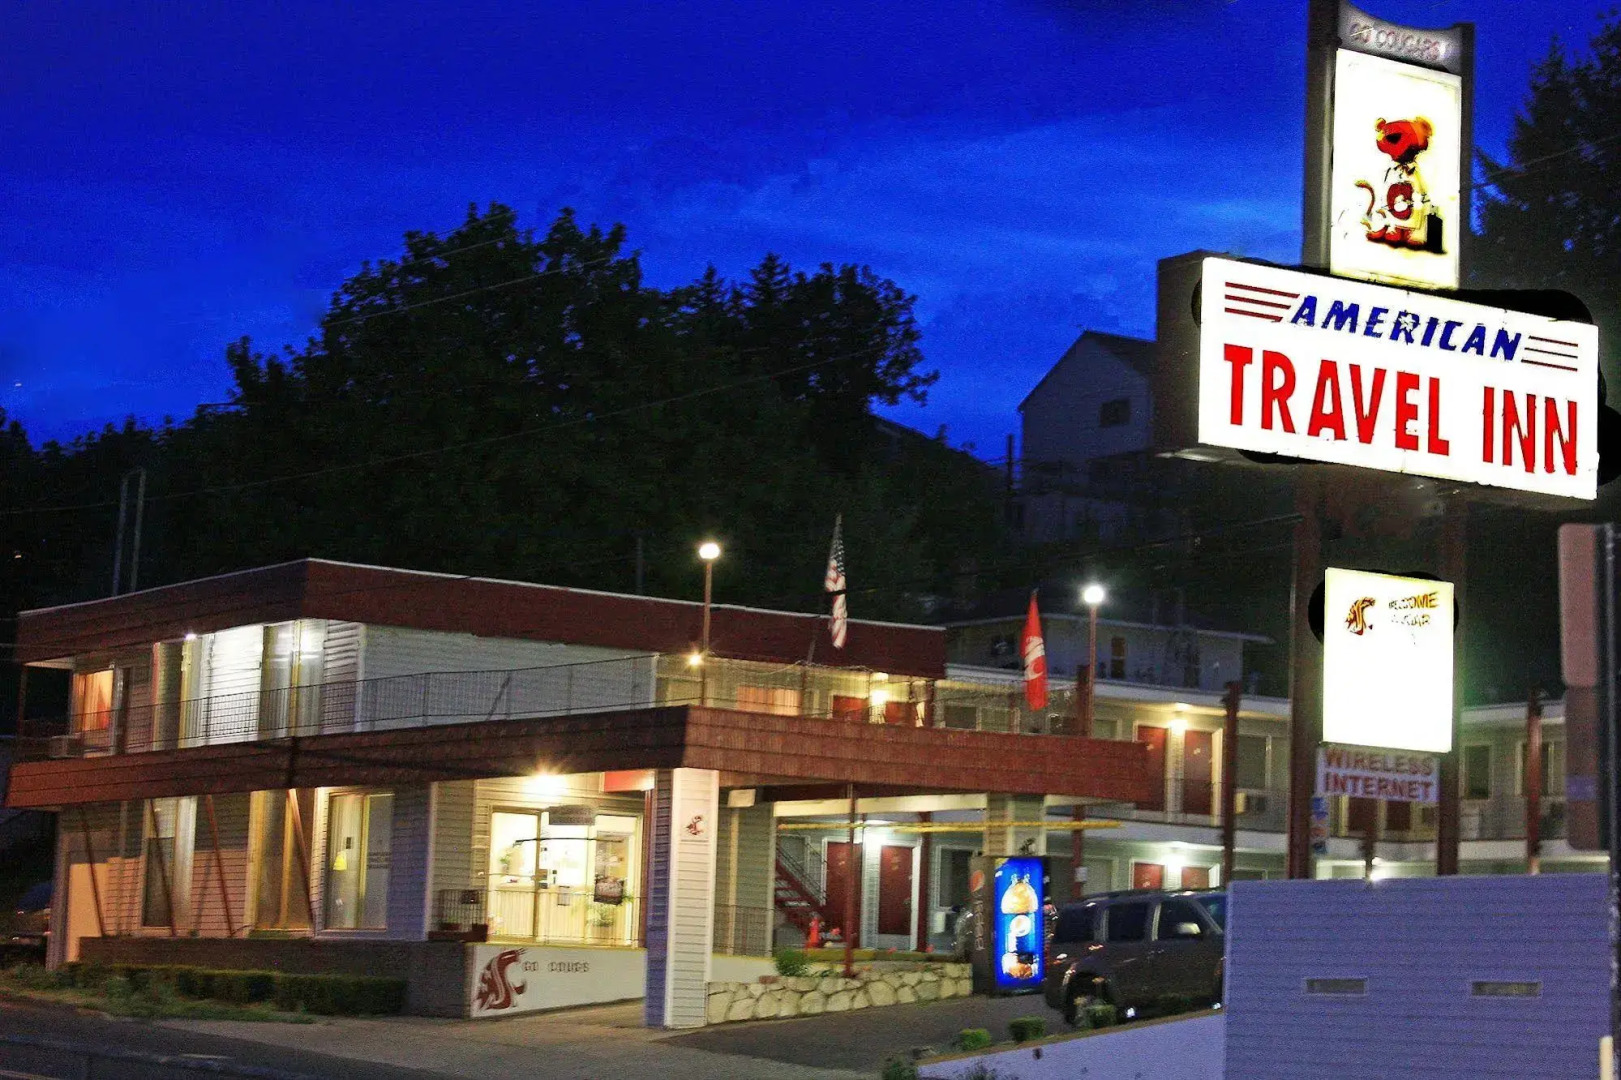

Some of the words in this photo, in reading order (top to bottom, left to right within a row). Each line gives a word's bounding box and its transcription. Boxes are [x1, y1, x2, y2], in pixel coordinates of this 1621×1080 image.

[1291, 295, 1522, 361] AMERICAN
[1224, 344, 1450, 456] TRAVEL
[1482, 386, 1577, 476] INN
[1388, 592, 1439, 610] COME
[1325, 747, 1433, 777] WIRELESS
[1325, 772, 1433, 799] INTERNET
